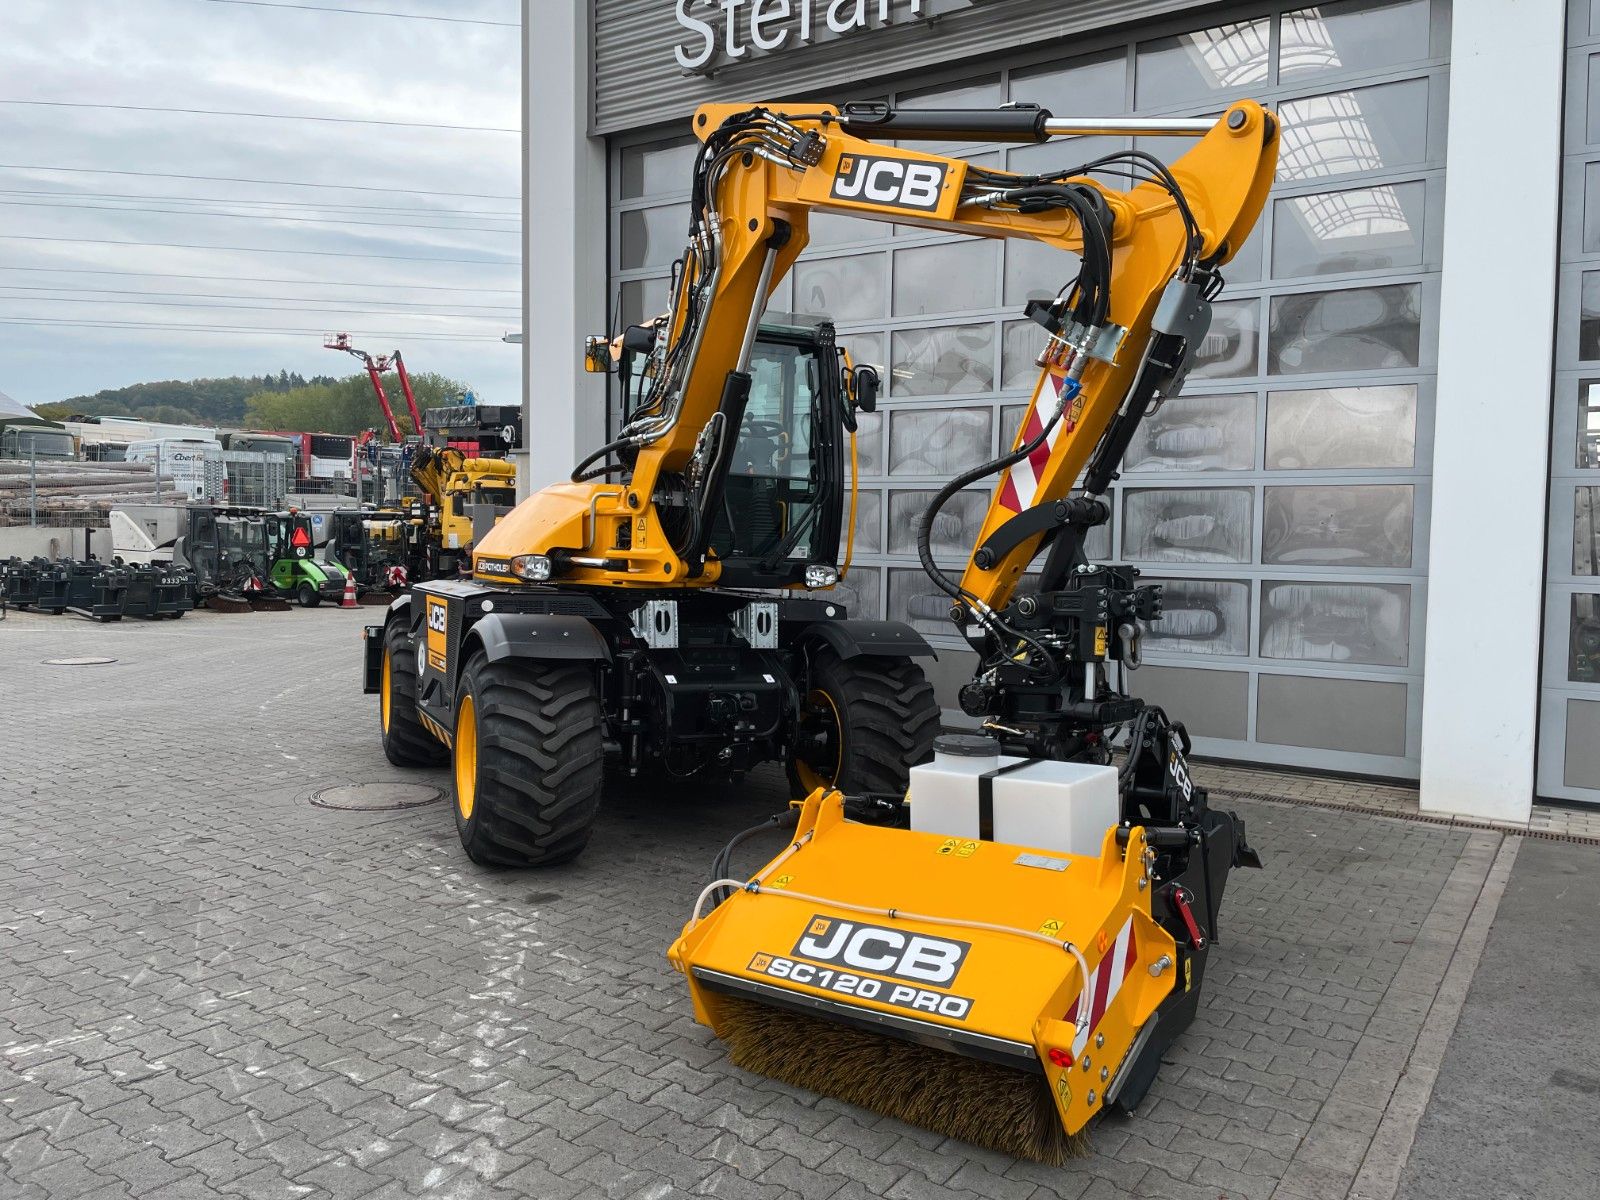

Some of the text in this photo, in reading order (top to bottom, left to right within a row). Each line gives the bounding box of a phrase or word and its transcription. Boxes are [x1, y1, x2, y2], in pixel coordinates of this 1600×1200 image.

[674, 0, 920, 69] Stea
[835, 159, 942, 207] JCB
[429, 604, 445, 632] JCB
[1169, 759, 1192, 802] JCB
[799, 923, 962, 983] JCB
[767, 958, 969, 1018] SC120 PRO
